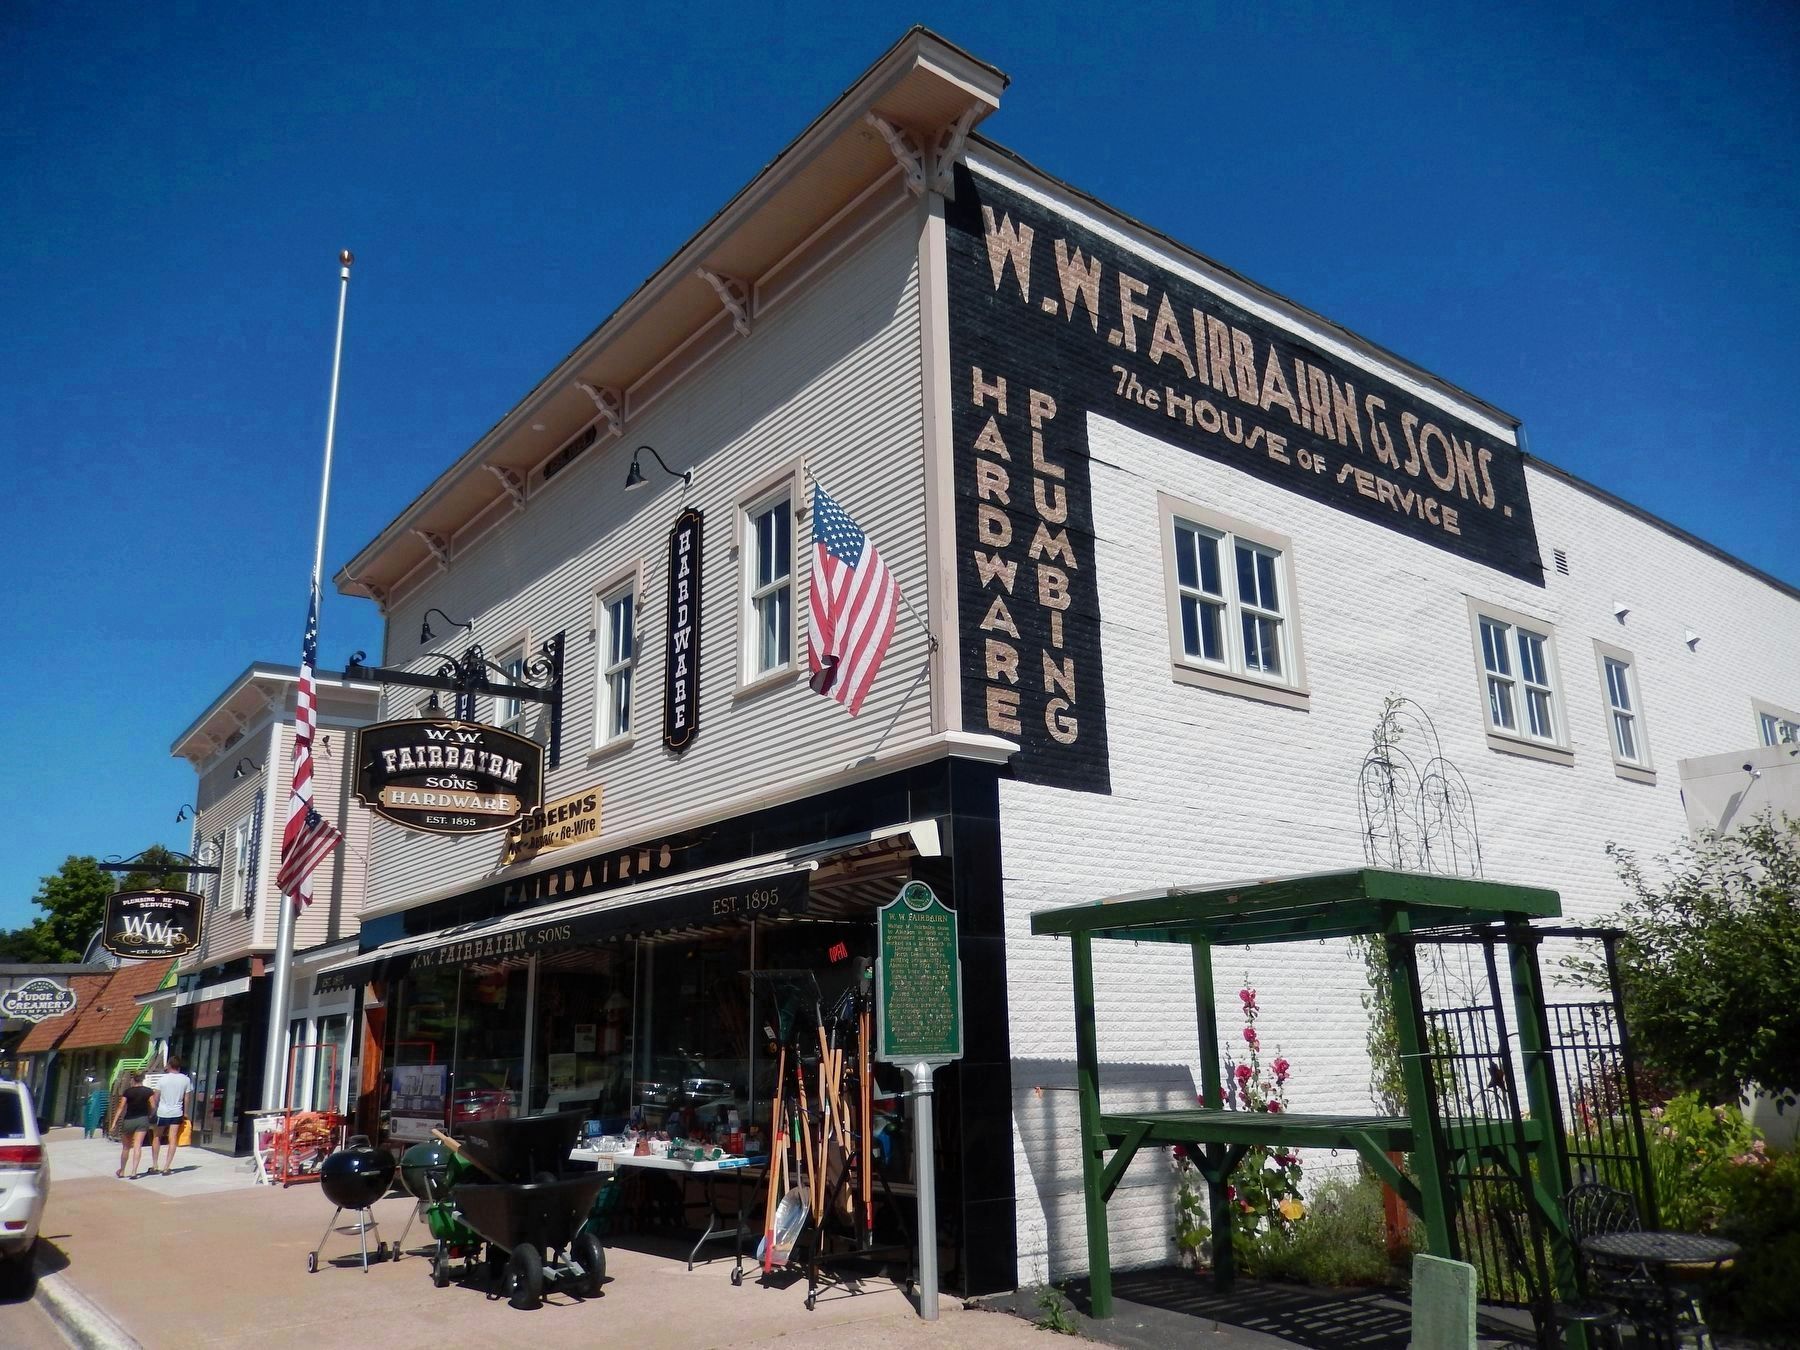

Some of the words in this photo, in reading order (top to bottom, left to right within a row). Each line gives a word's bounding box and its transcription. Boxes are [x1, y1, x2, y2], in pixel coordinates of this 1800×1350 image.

[1118, 271, 1364, 455] FAIRBAIRN
[1367, 393, 1399, 470] &
[1111, 364, 1161, 412] The
[1166, 387, 1291, 465] HOUSE
[1296, 446, 1327, 475] OF
[1336, 460, 1461, 536] SERVICE
[971, 366, 1023, 736] HARDWARE
[1028, 388, 1079, 745] PLUMBING
[673, 528, 692, 729] HARDWARE
[423, 728, 485, 745] W.W.
[381, 745, 524, 784] FAIRBAIRN
[425, 776, 479, 791] SONS
[391, 789, 511, 812] HARDWARE
[509, 794, 597, 838] SCREENS
[426, 815, 448, 825] EST.
[452, 816, 476, 826] 1895
[560, 817, 597, 841] Re-Wire
[122, 896, 156, 906] PLUMBING
[712, 895, 740, 915] EST.
[745, 887, 779, 910] 1895
[122, 911, 184, 948] WWF
[908, 913, 948, 922] FAIRBAIRN
[437, 930, 527, 965] FAIRBAIRN
[537, 924, 572, 945] SONS
[828, 941, 848, 964] OPEN
